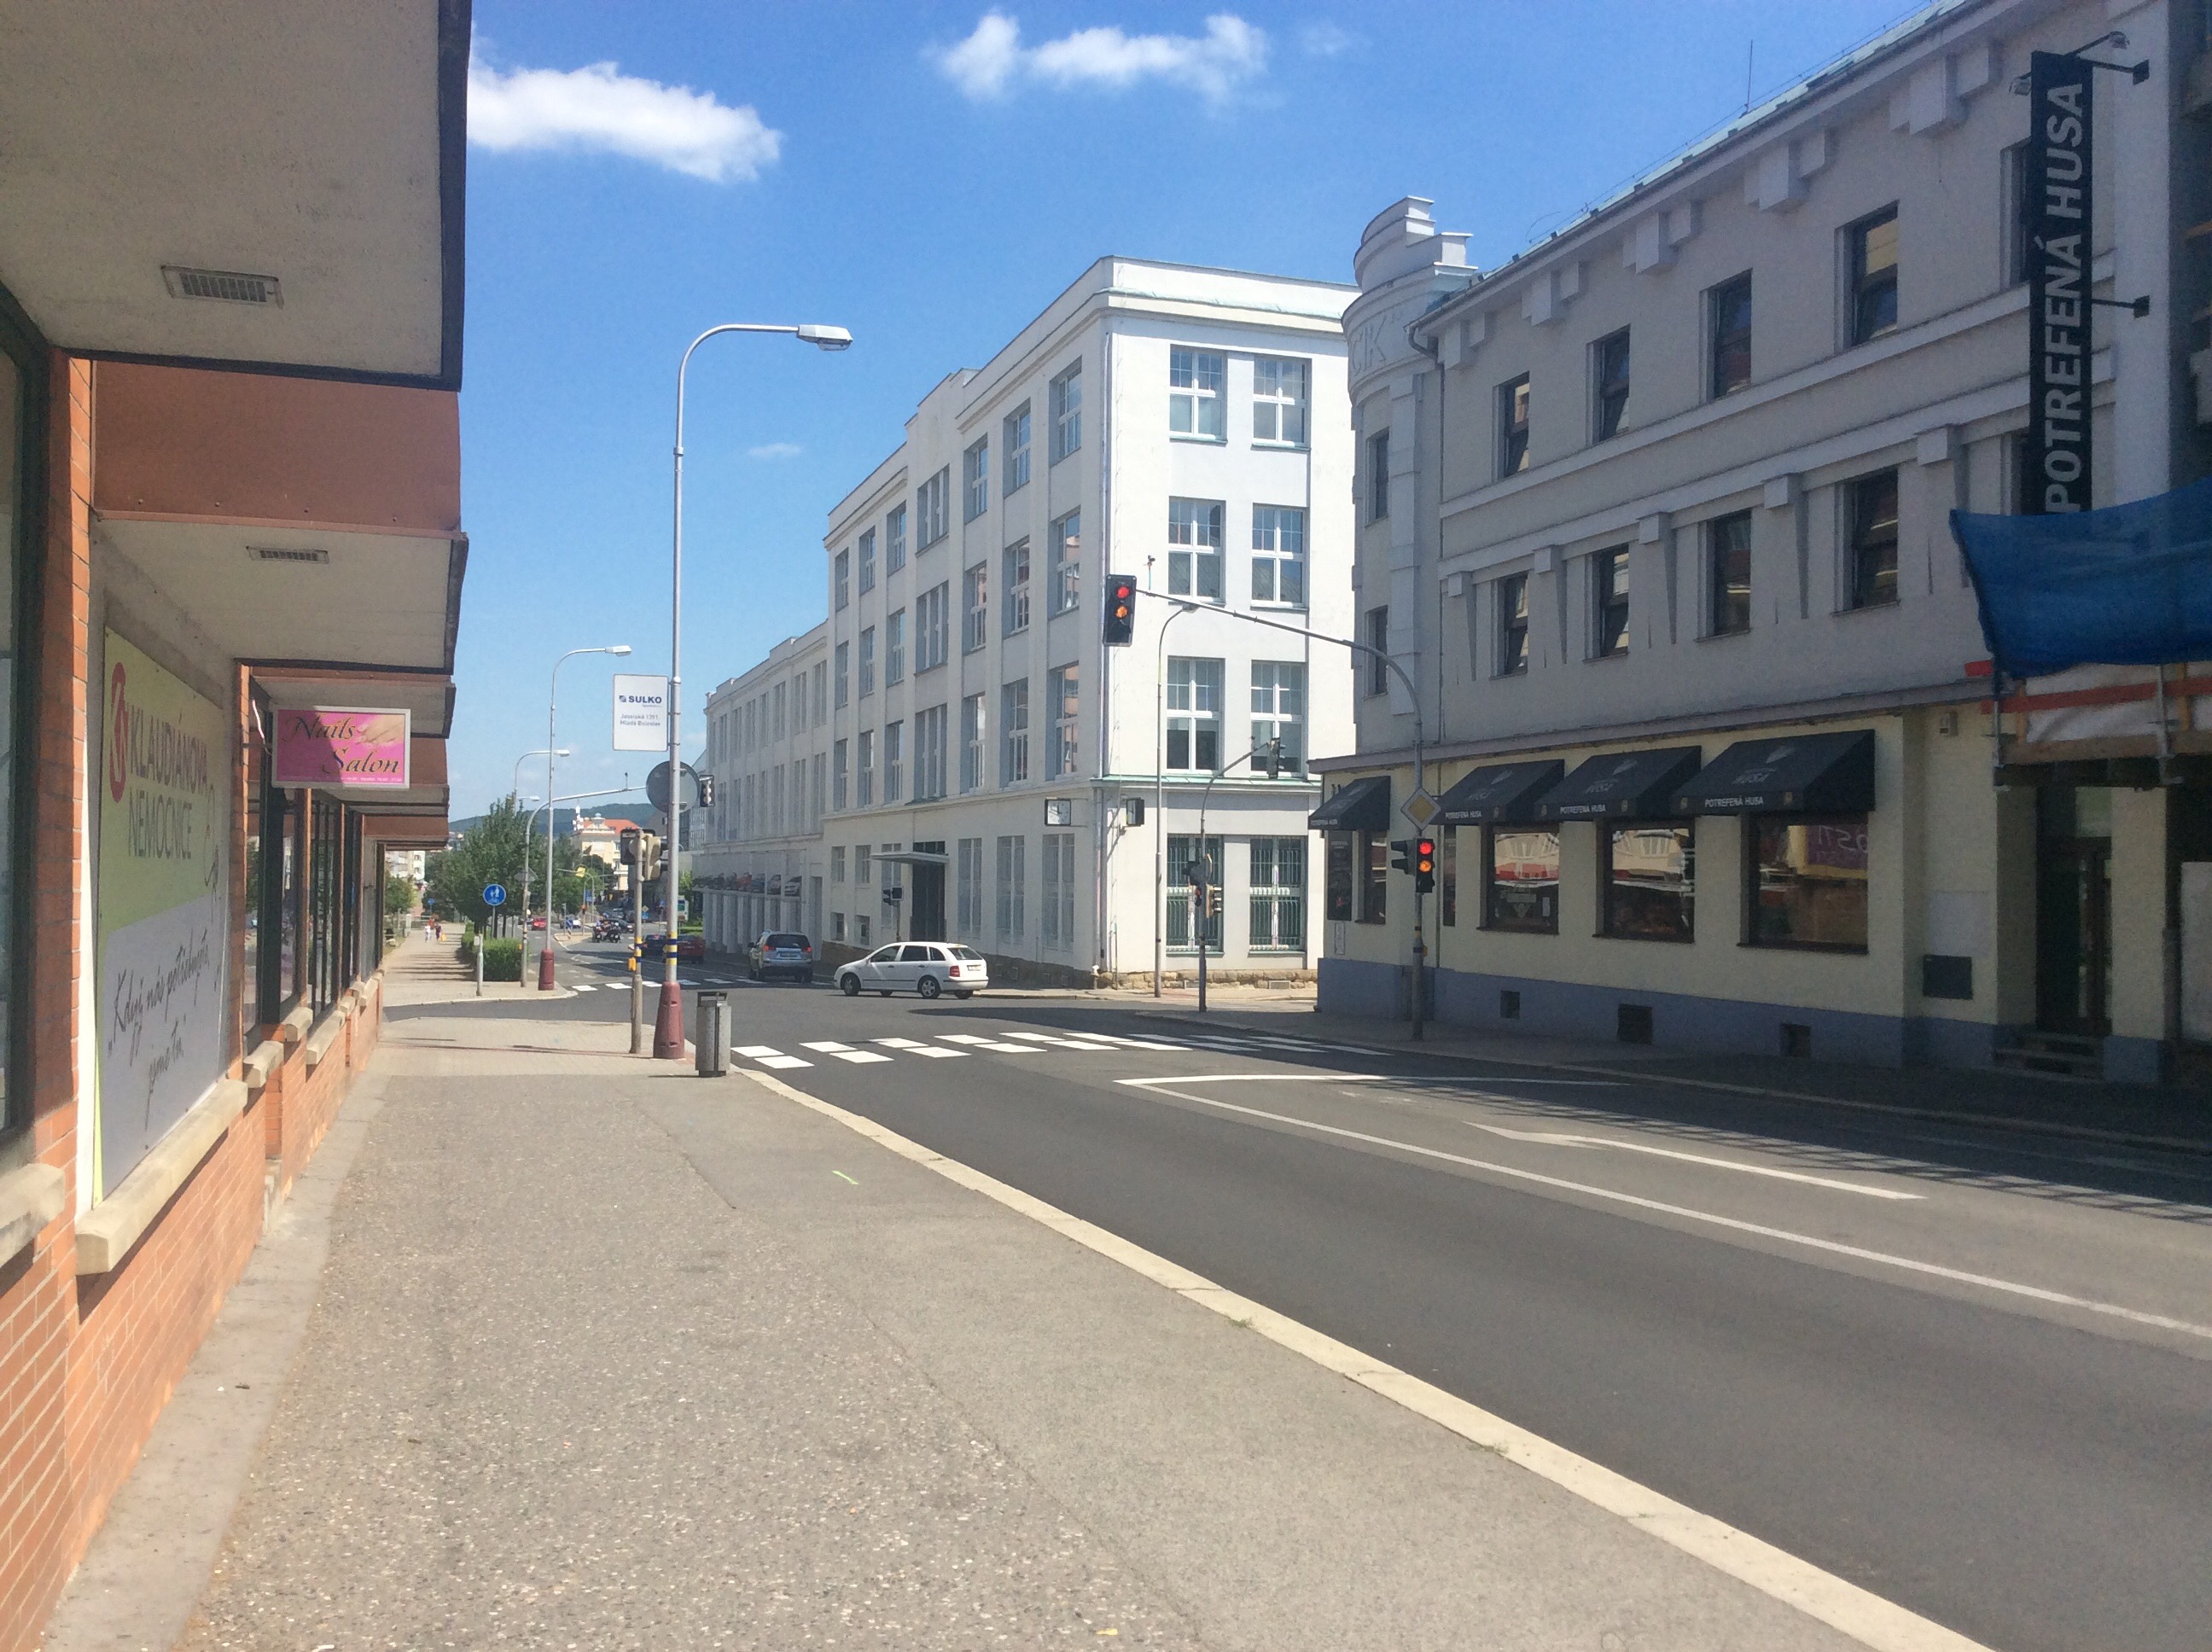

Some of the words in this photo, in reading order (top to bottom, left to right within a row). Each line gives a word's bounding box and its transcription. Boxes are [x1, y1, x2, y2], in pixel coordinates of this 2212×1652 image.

[2046, 83, 2083, 219] HUSA
[2034, 234, 2082, 513] POTREFENÁ
[282, 715, 355, 742] Nails
[322, 747, 399, 773] Salon
[1591, 804, 1606, 812] HUSA
[1705, 795, 1743, 807] POTREFENÁ
[1744, 796, 1764, 806] HUSA
